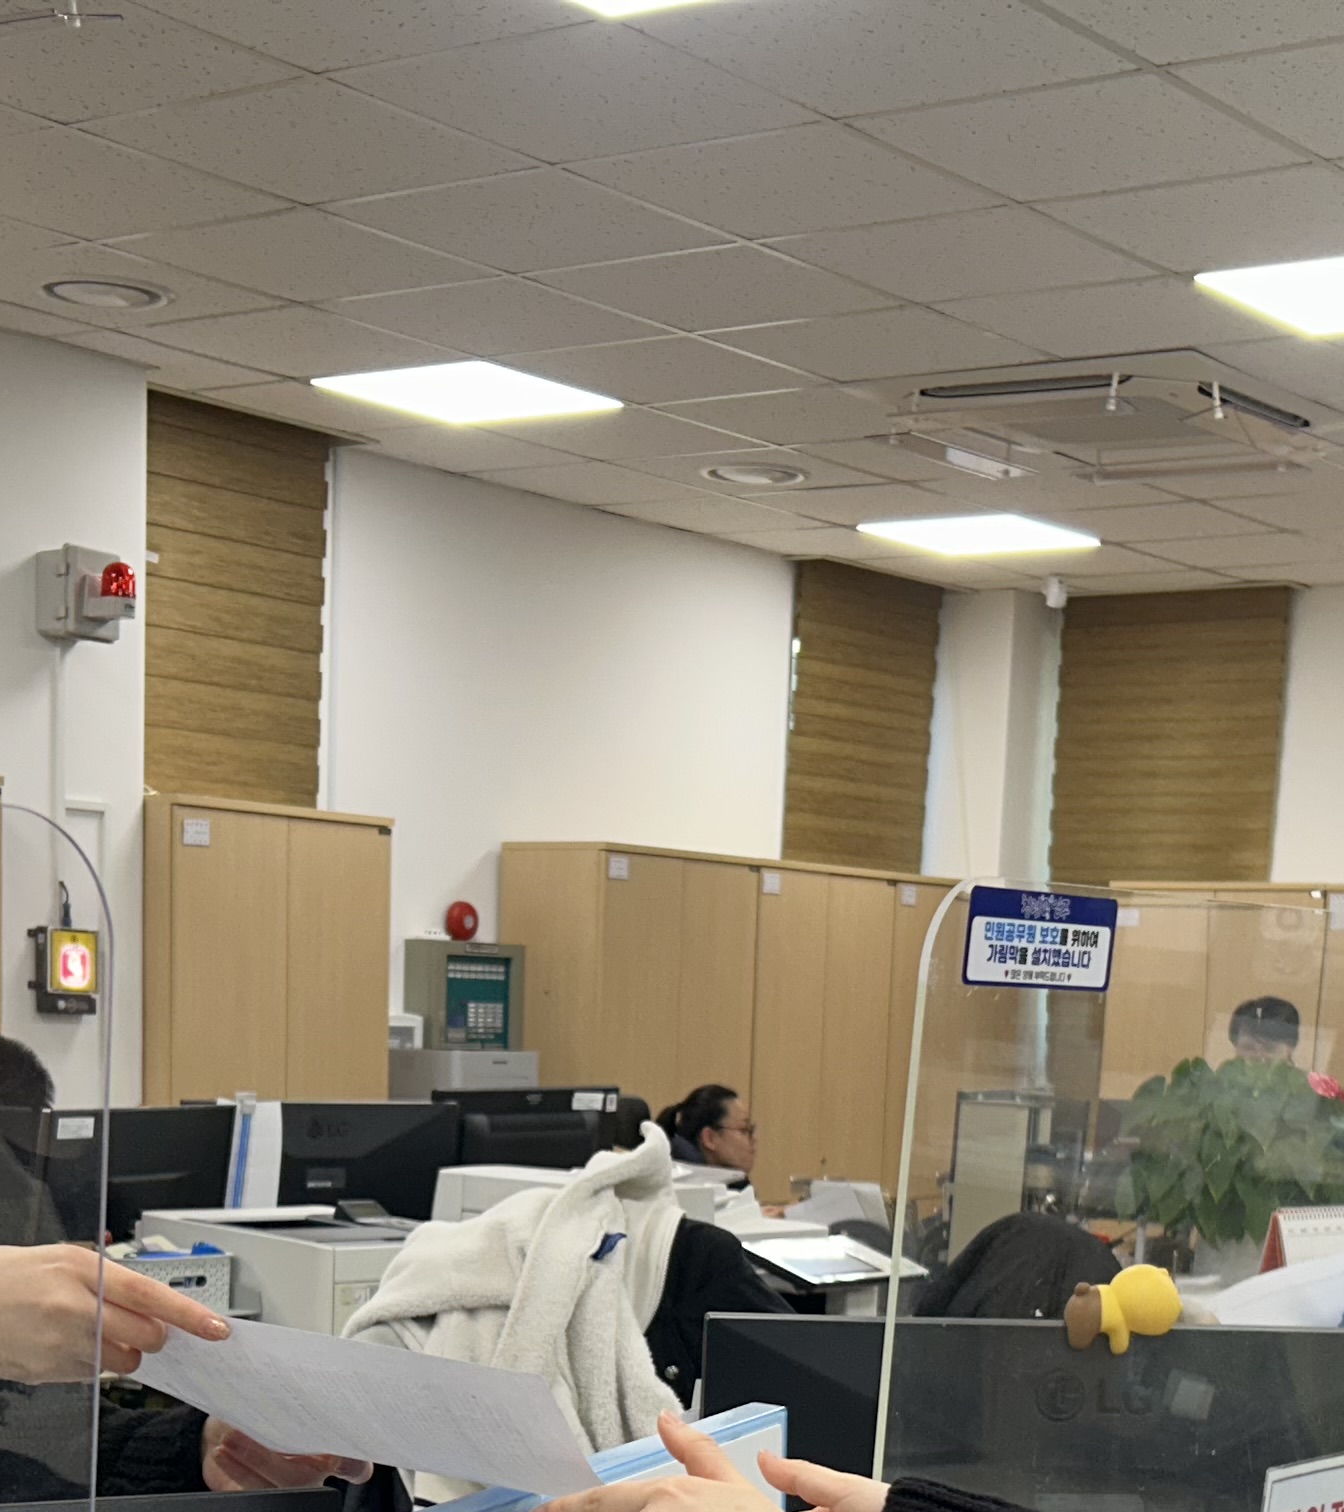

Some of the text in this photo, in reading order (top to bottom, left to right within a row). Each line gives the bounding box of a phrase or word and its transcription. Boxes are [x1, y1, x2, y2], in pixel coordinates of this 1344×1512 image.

[983, 921, 1099, 949] 민원공무원 보호를 위하여
[986, 944, 1093, 969] 가림막을 설치했습니다
